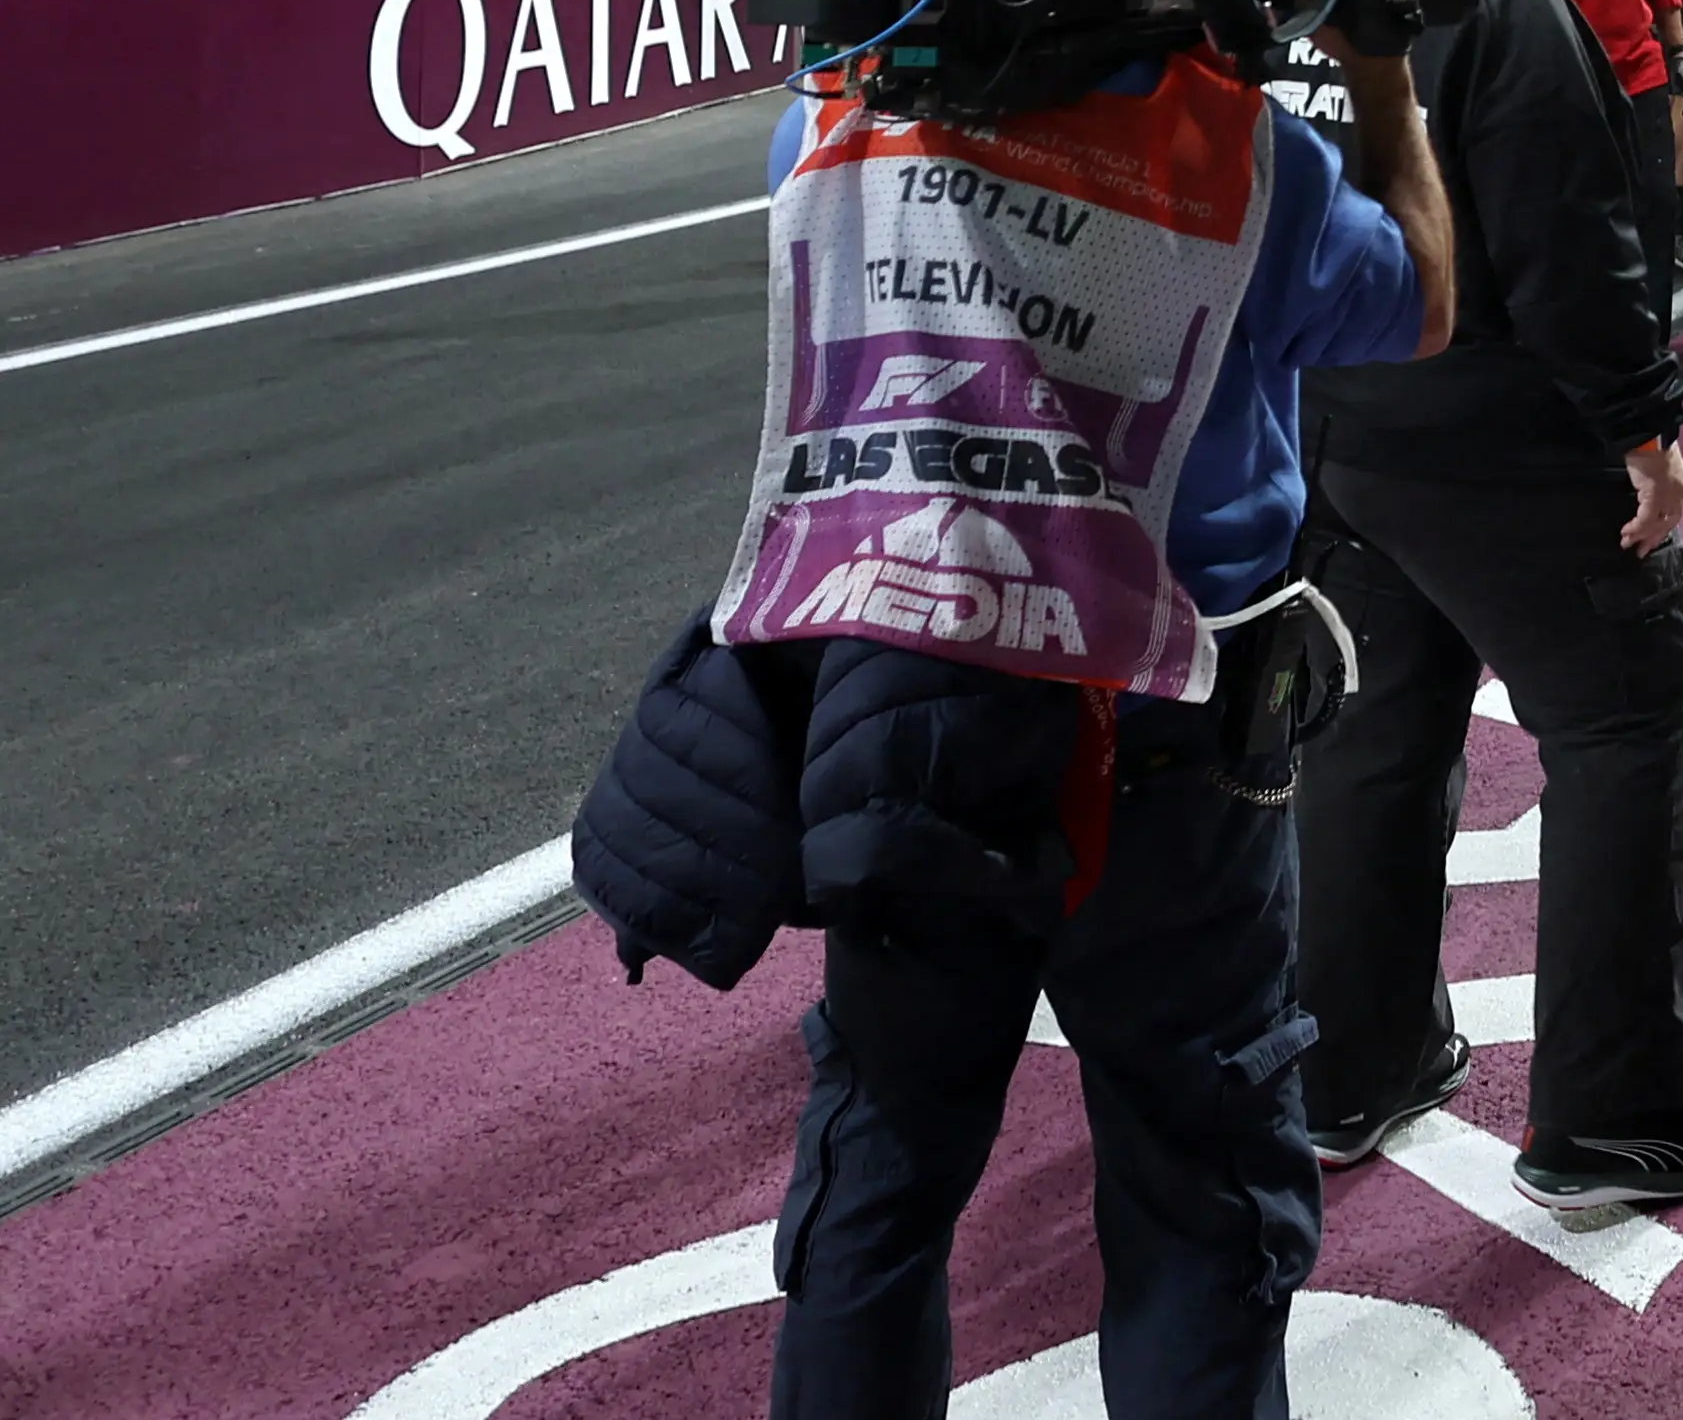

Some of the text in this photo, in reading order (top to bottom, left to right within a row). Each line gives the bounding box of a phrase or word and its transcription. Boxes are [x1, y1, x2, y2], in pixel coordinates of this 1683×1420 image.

[898, 164, 1090, 247] 1901-LV
[783, 430, 1107, 500] LAS VEGAS
[783, 560, 1088, 656] MEDIA
